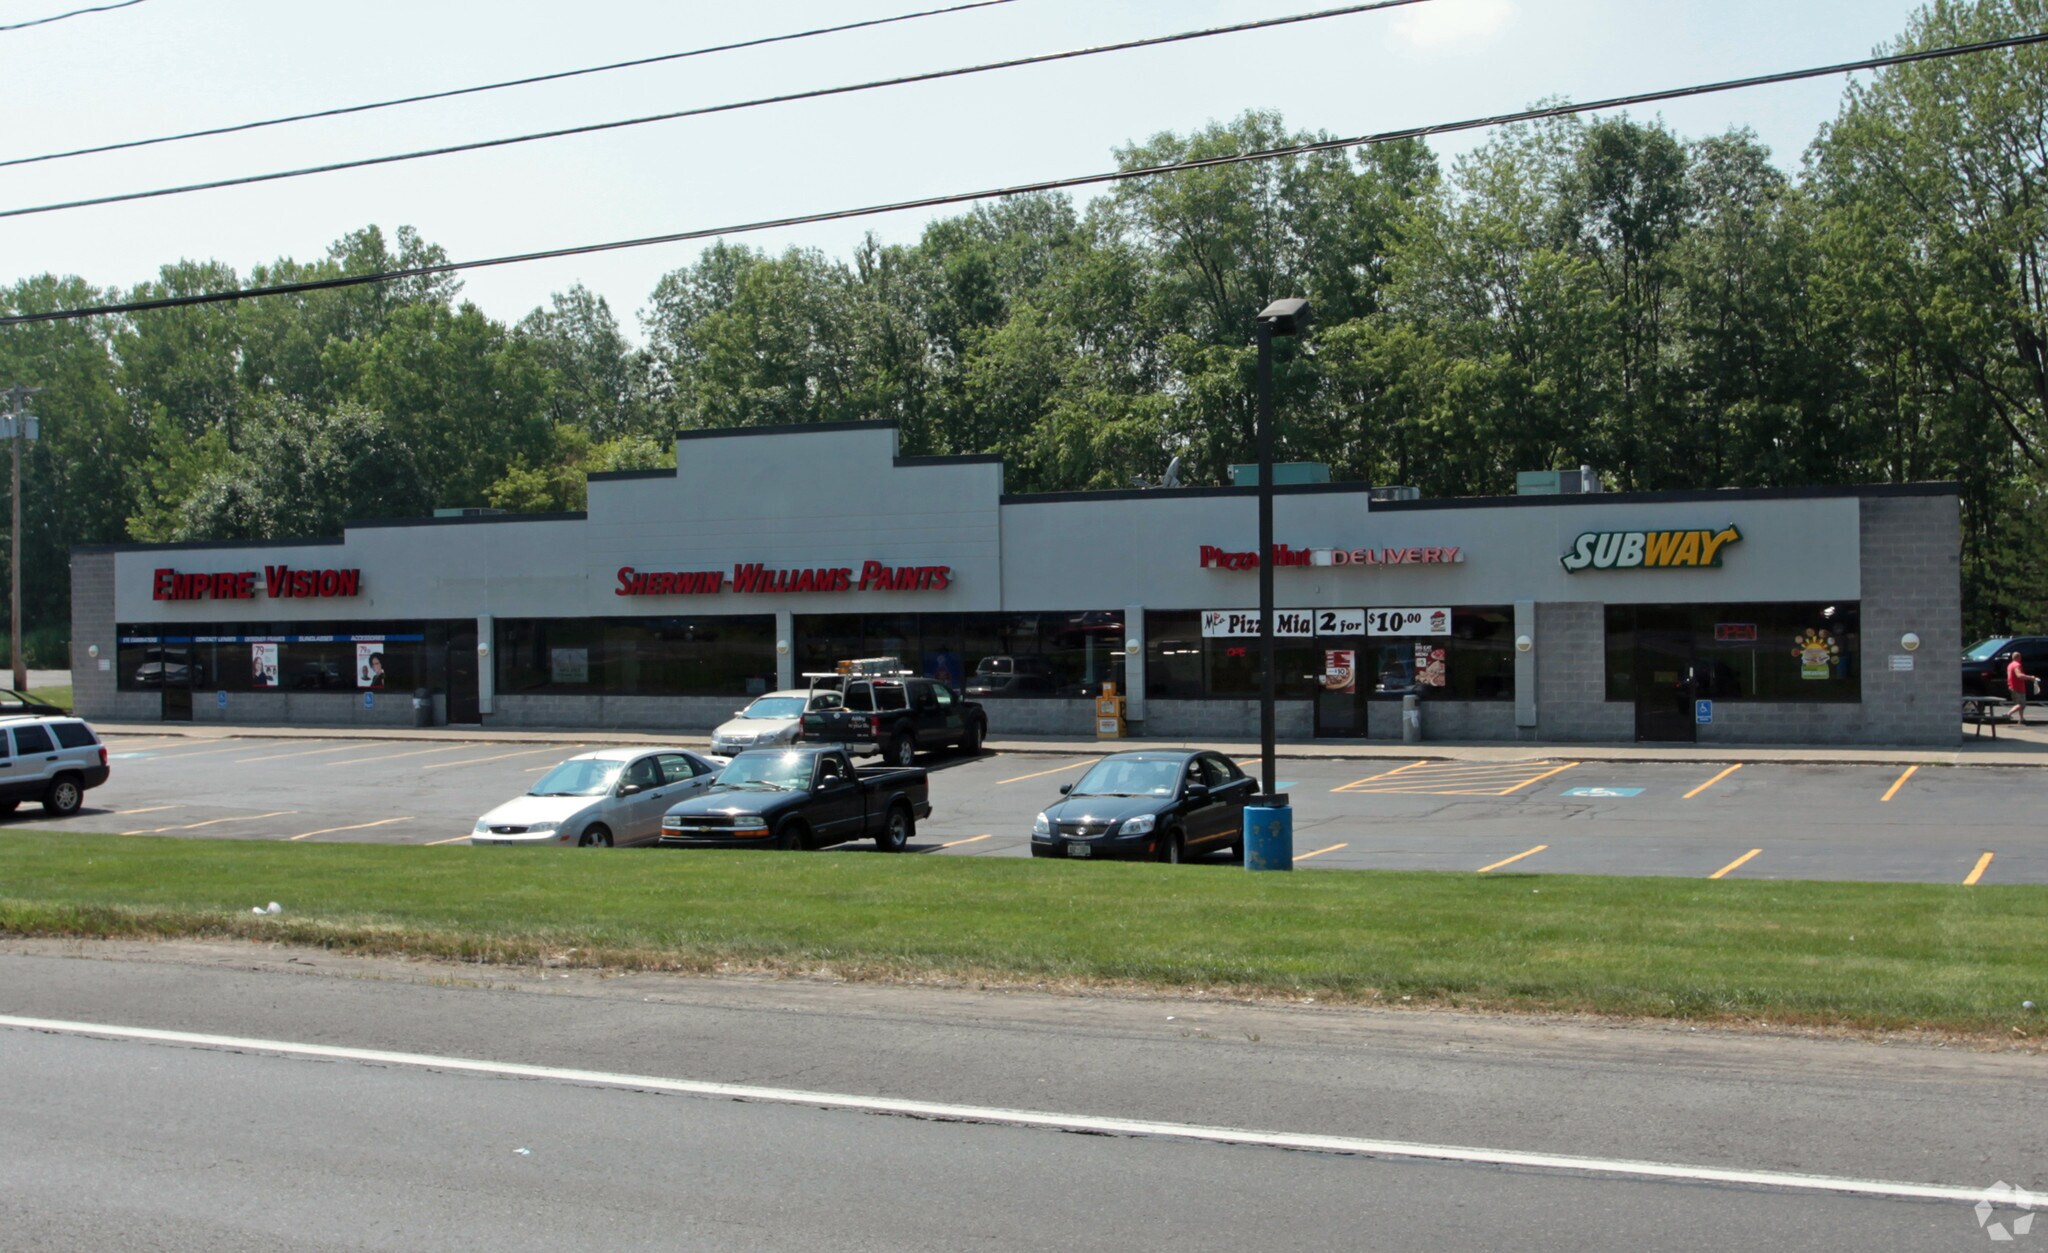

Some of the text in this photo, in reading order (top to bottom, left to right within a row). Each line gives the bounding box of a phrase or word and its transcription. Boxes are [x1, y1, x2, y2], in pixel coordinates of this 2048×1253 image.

[1200, 544, 1460, 571] Pizza Hut DELIVERY
[1563, 527, 1739, 571] SUBWAY
[153, 565, 360, 600] EMPIRE VISION
[615, 561, 951, 597] SHERWIN-WILLIAMS PAINTS
[1228, 614, 1261, 633] Pizz
[1277, 614, 1311, 633] Mia
[1320, 612, 1336, 631] 2
[1340, 620, 1361, 632] for
